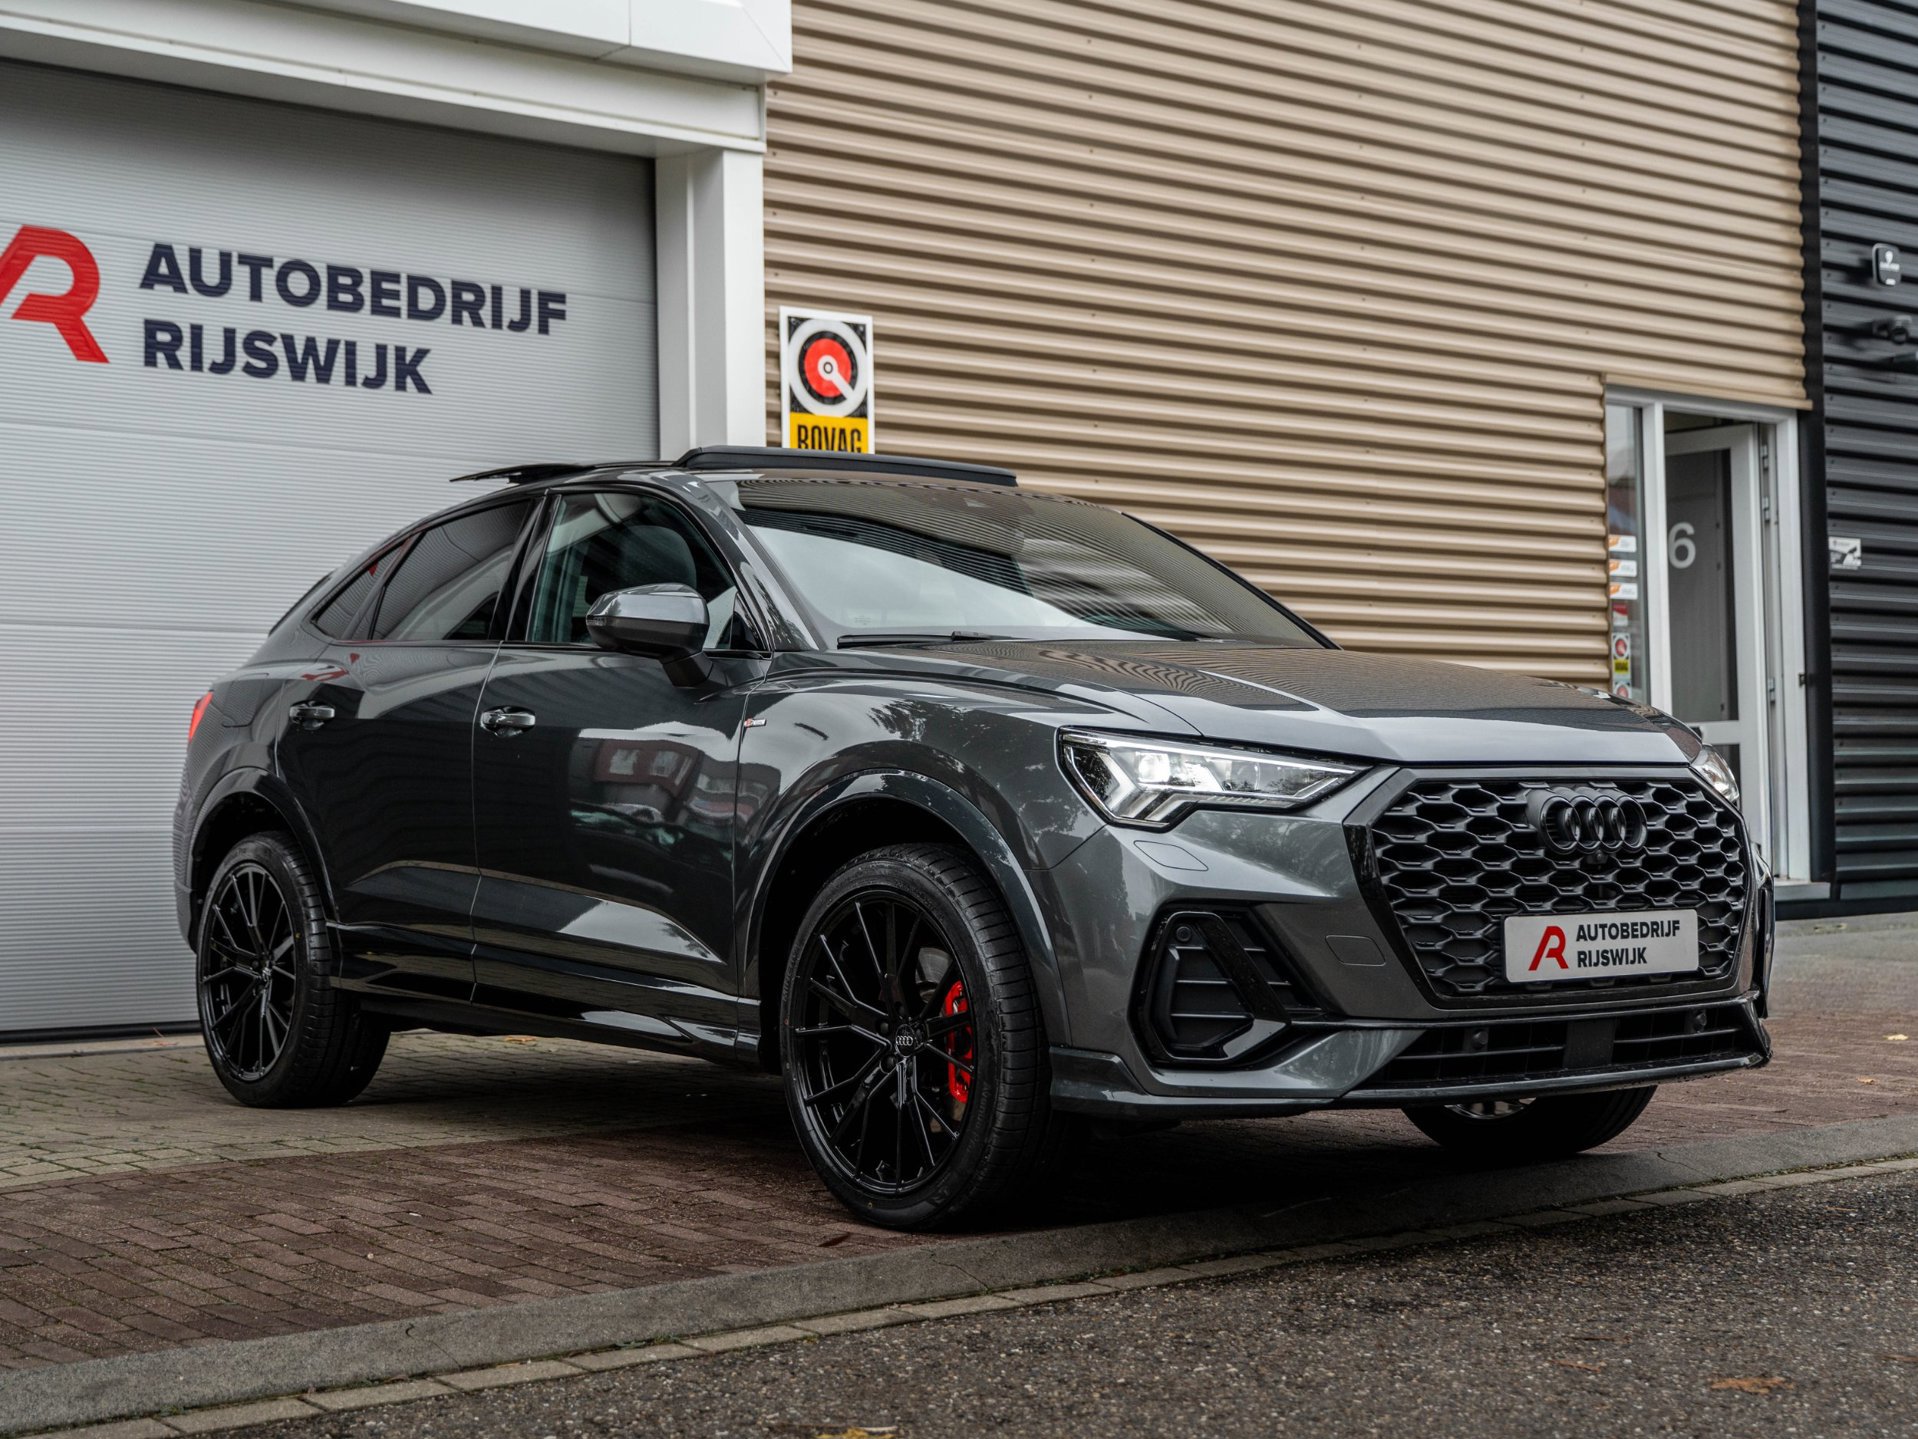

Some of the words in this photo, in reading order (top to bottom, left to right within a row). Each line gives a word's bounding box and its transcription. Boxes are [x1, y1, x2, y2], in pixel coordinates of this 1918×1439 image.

[140, 243, 567, 335] AUTOBEDRIJF
[143, 319, 432, 394] RIJSWIJK
[797, 424, 862, 452] BOVAG
[1668, 522, 1696, 569] 6
[1576, 919, 1681, 942] AUTOBEDRIJF
[1577, 947, 1647, 968] RIJSWIJK
